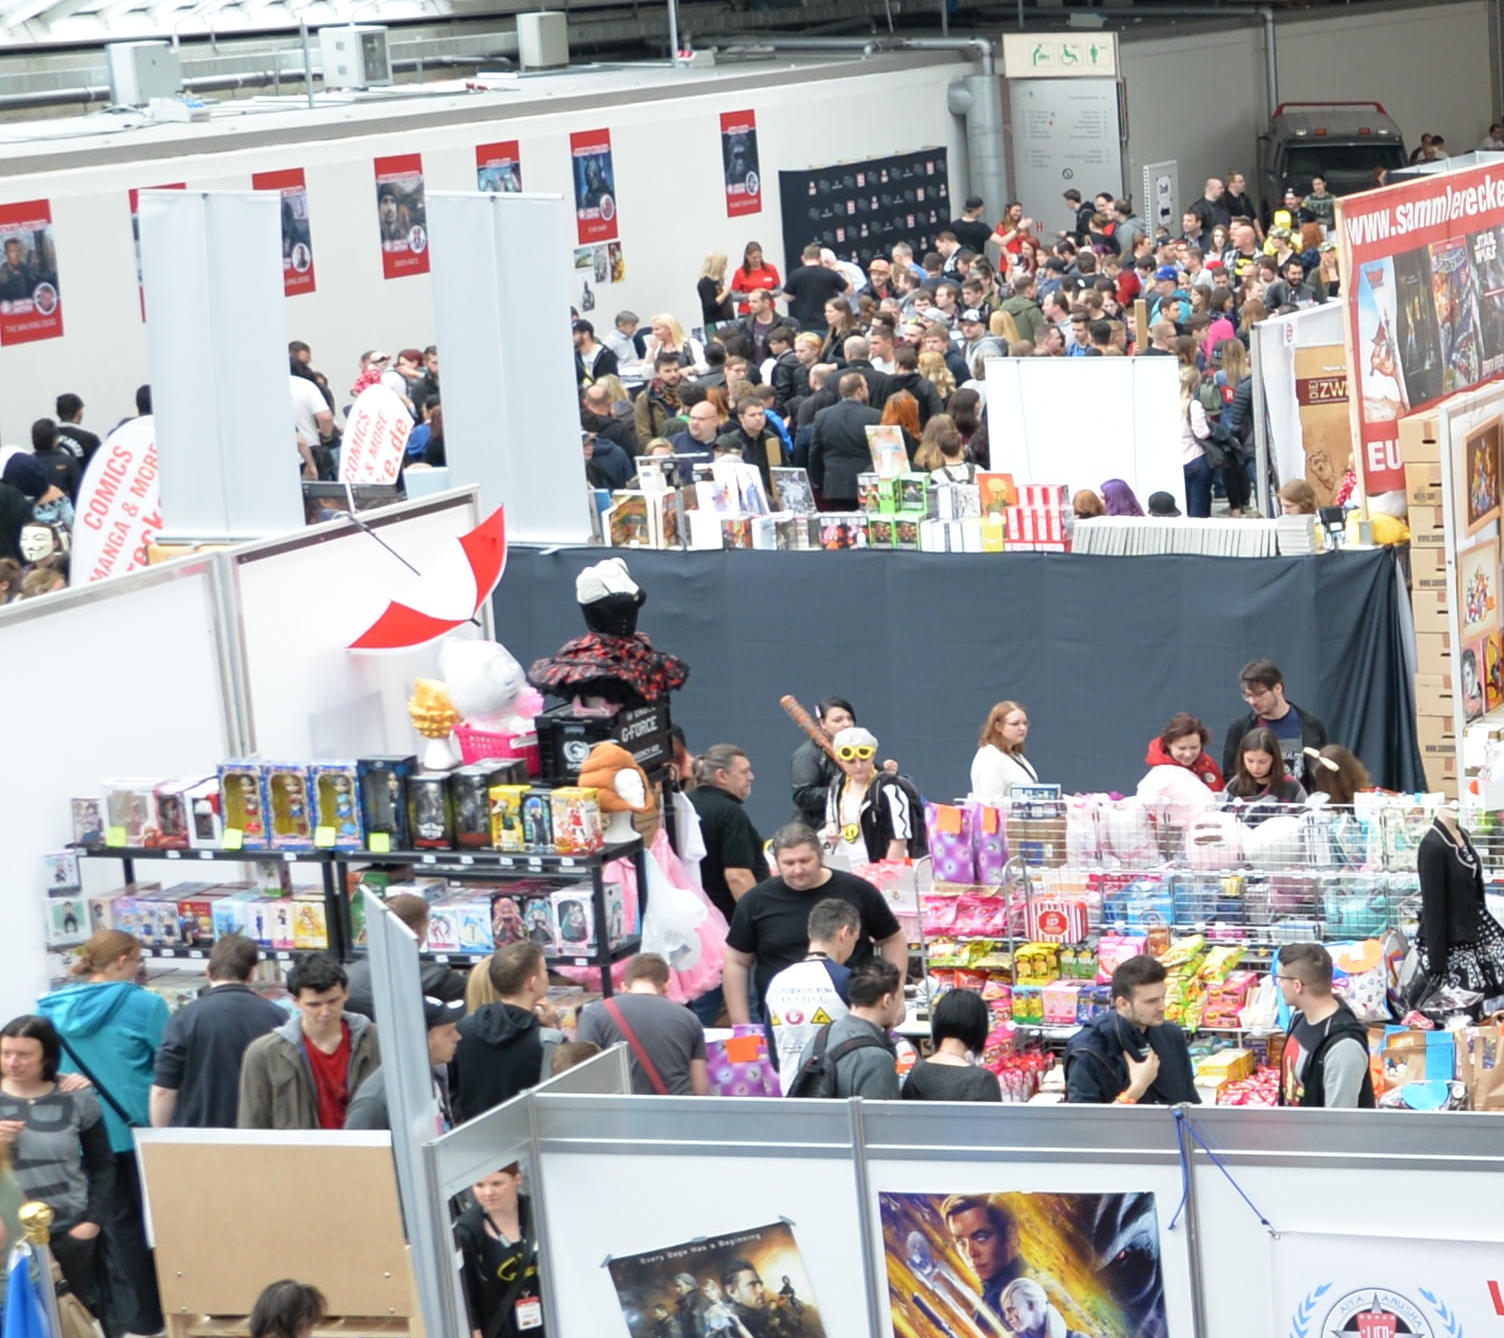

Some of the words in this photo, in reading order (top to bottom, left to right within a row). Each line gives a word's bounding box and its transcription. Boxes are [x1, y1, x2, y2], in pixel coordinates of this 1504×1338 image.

[345, 408, 371, 483] COMICS
[367, 411, 389, 458] MORE
[82, 444, 134, 532] COMICS
